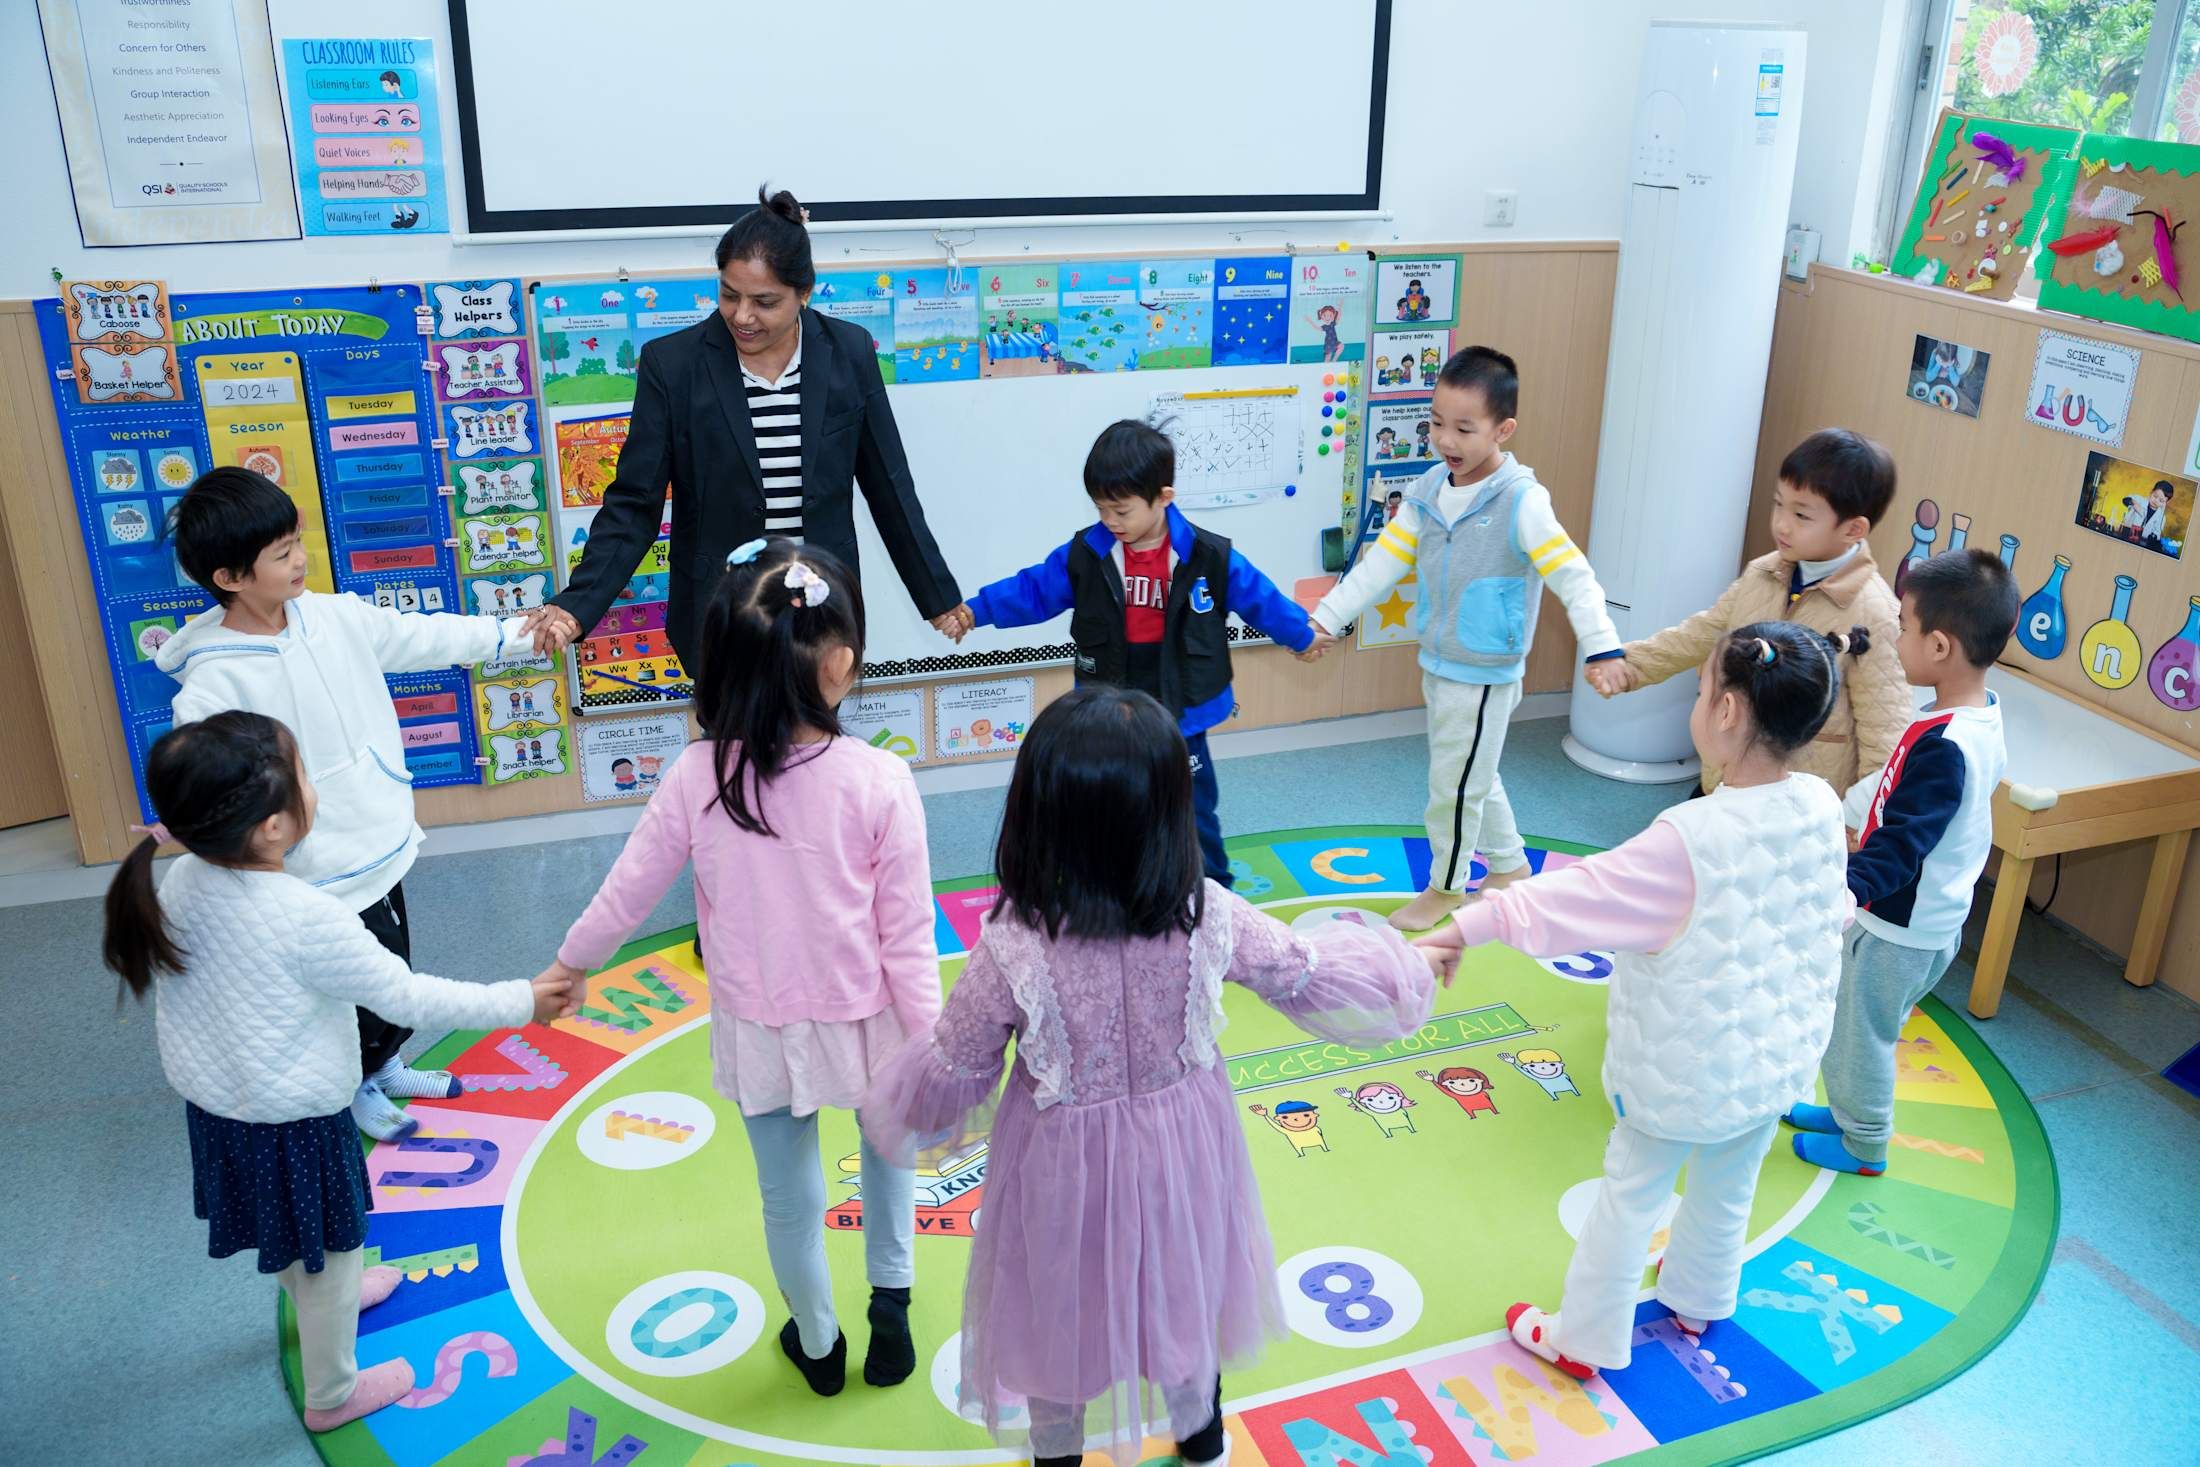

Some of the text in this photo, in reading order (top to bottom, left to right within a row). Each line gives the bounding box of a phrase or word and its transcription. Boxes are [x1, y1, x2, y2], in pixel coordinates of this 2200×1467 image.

[128, 20, 190, 31] Responsibility
[119, 43, 207, 53] Concern for Others
[302, 41, 416, 65] CLASSROOM RULES
[112, 66, 220, 76] Kindness and Politeness
[311, 79, 370, 91] Listening Ears
[131, 89, 210, 100] Group Interaction
[124, 111, 224, 122] Aesthetic Appreciation
[315, 112, 369, 125] Looking Eyes
[127, 134, 227, 146] Independent Endeavor
[319, 147, 370, 158] Quiet Voices
[142, 185, 163, 195] QSI
[322, 178, 384, 191] Helping Hands
[326, 211, 380, 223] Walking Feet
[1149, 270, 1157, 285] 8
[1188, 272, 1208, 284] Eight
[1225, 267, 1237, 283] 9
[1265, 269, 1284, 280] Nine
[1302, 265, 1318, 281] 10
[1344, 268, 1357, 277] Ten
[907, 279, 917, 295] 5
[990, 276, 1001, 291] 6
[1036, 279, 1049, 288] Six
[867, 287, 886, 297] Four
[461, 295, 492, 306] Class
[601, 298, 619, 309] One
[454, 312, 502, 323] Helpers
[100, 319, 141, 329] Caboose
[183, 313, 345, 343] ABOUT TODAY
[346, 349, 380, 360] Days
[2066, 348, 2106, 366] SCIENCE
[230, 361, 265, 372] Year
[94, 380, 165, 391] Basket Helper
[450, 378, 519, 390] Teacher Assistant
[223, 383, 280, 400] 2024
[348, 399, 393, 410] Tuesday
[230, 422, 284, 434] Season
[110, 429, 171, 441] Weather
[342, 430, 406, 443] Wednesday
[470, 435, 517, 446] Line leader
[356, 462, 404, 473] Thursday
[368, 494, 401, 504] Friday
[470, 492, 531, 505] Plant monitor
[363, 523, 410, 535] Saturday
[652, 544, 666, 554] Dd
[374, 552, 413, 564] Sunday
[473, 549, 539, 562] Calendar helper
[375, 580, 415, 591] Dates
[143, 599, 204, 612] Seasons
[380, 596, 390, 608] 2
[402, 594, 414, 606] 3
[429, 593, 438, 604] 4
[609, 637, 621, 646] Rr
[636, 634, 648, 642] Ss
[2029, 612, 2191, 699] e n c
[485, 657, 548, 670] Curtain Helper
[608, 664, 629, 673] Ww
[639, 661, 653, 670] Xx
[665, 657, 678, 667] Yy
[394, 683, 442, 694] Months
[961, 687, 1007, 699] LITERACY
[410, 702, 434, 712] April
[858, 701, 886, 712] MATH
[507, 710, 544, 719] Librarian
[408, 731, 442, 742] August
[598, 725, 665, 740] CIRCLE TIME
[408, 760, 453, 771] ecember
[503, 757, 556, 770] Snack helper
[1310, 847, 1386, 884] C
[574, 966, 695, 1035] W
[1231, 1044, 1371, 1085] UCCESS
[1458, 1015, 1520, 1040] ALL
[462, 1034, 568, 1091] V
[377, 1133, 500, 1192] U
[1298, 1262, 1394, 1333] 8
